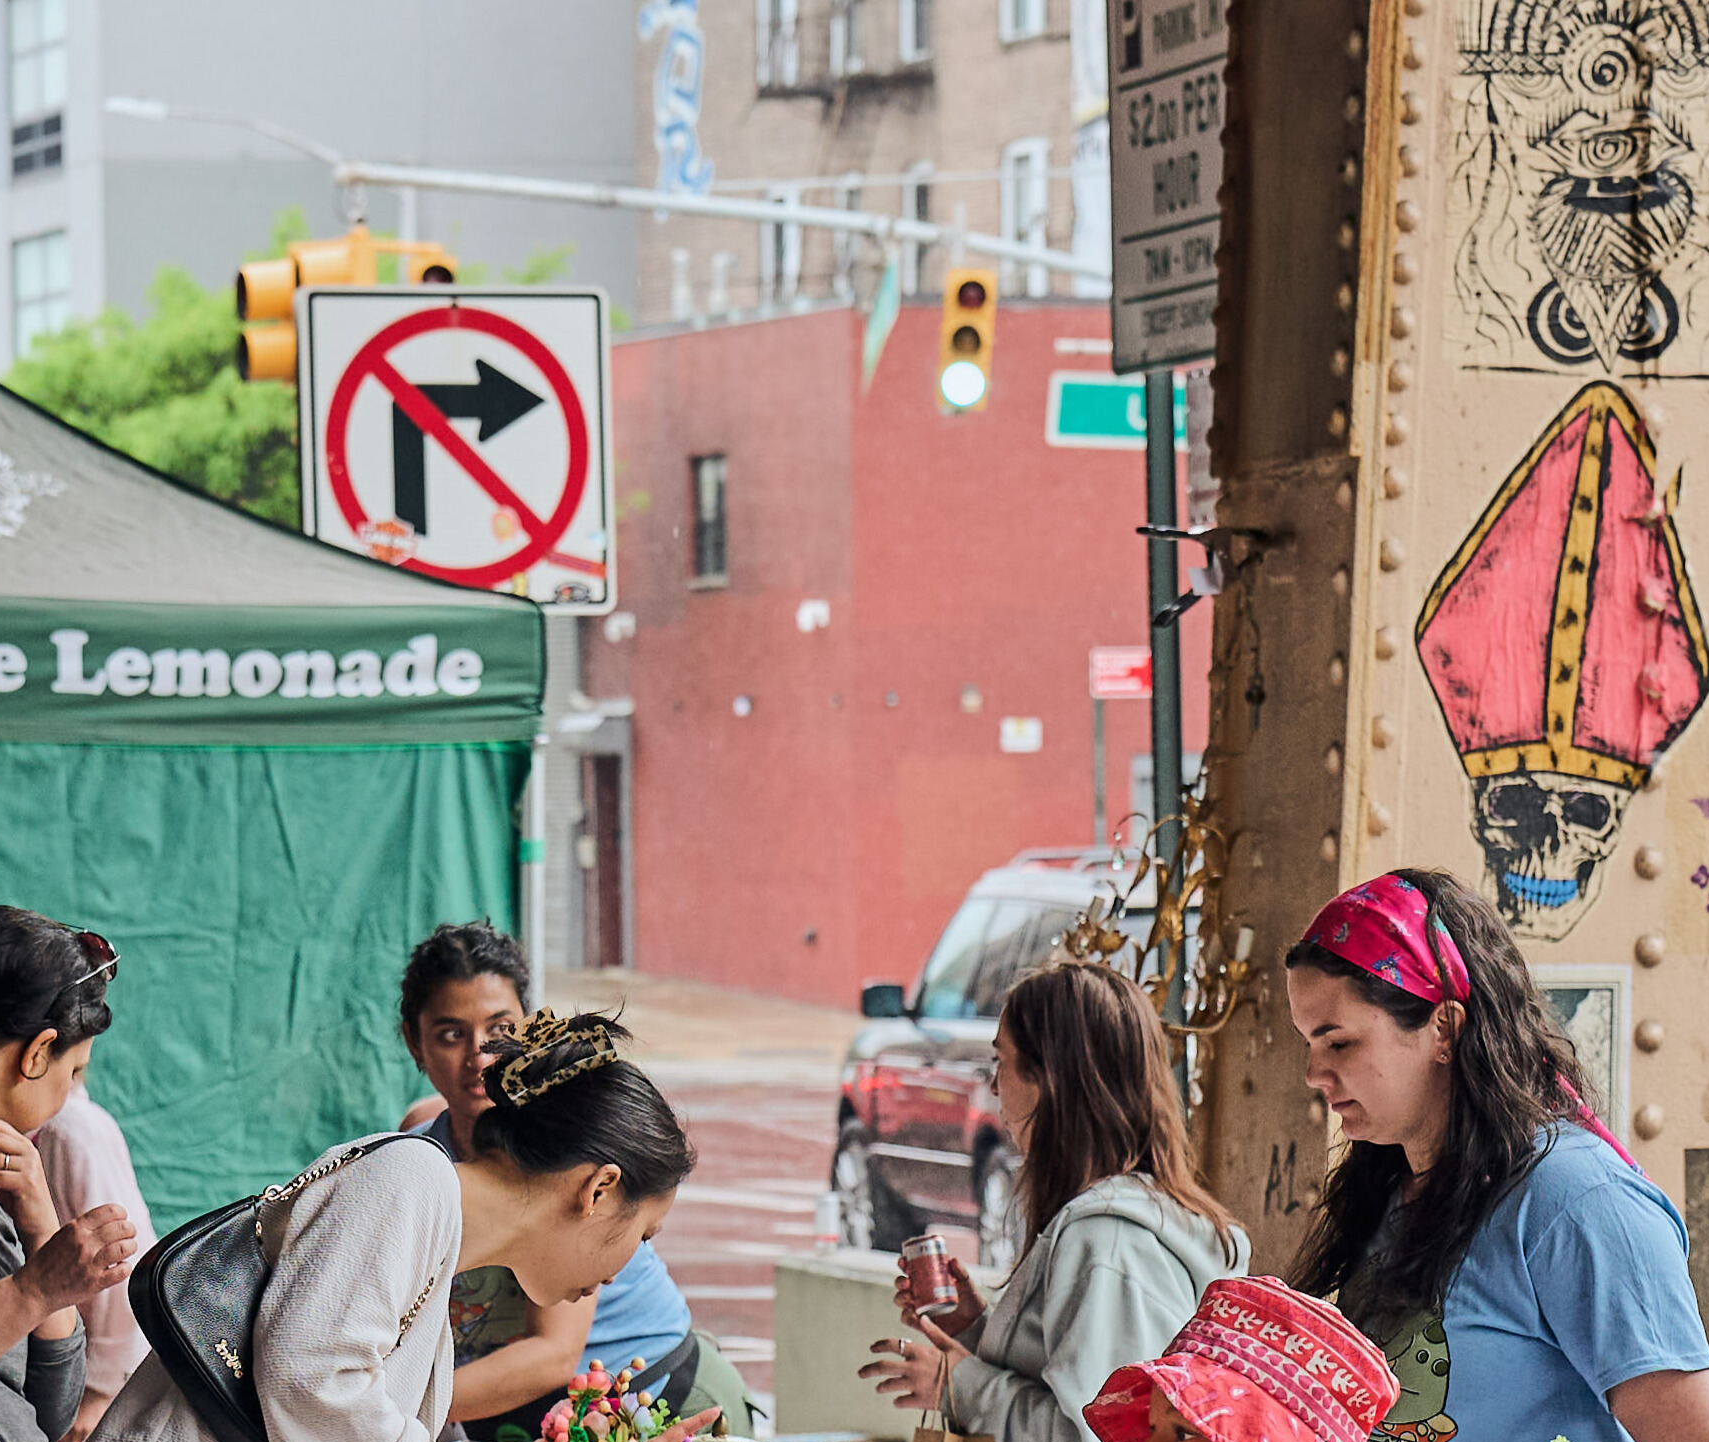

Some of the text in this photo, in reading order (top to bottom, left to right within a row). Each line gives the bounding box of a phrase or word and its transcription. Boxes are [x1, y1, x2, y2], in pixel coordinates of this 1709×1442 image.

[1183, 72, 1220, 137] PER
[1153, 152, 1200, 215] HOUR
[49, 629, 484, 698] Lemonade
